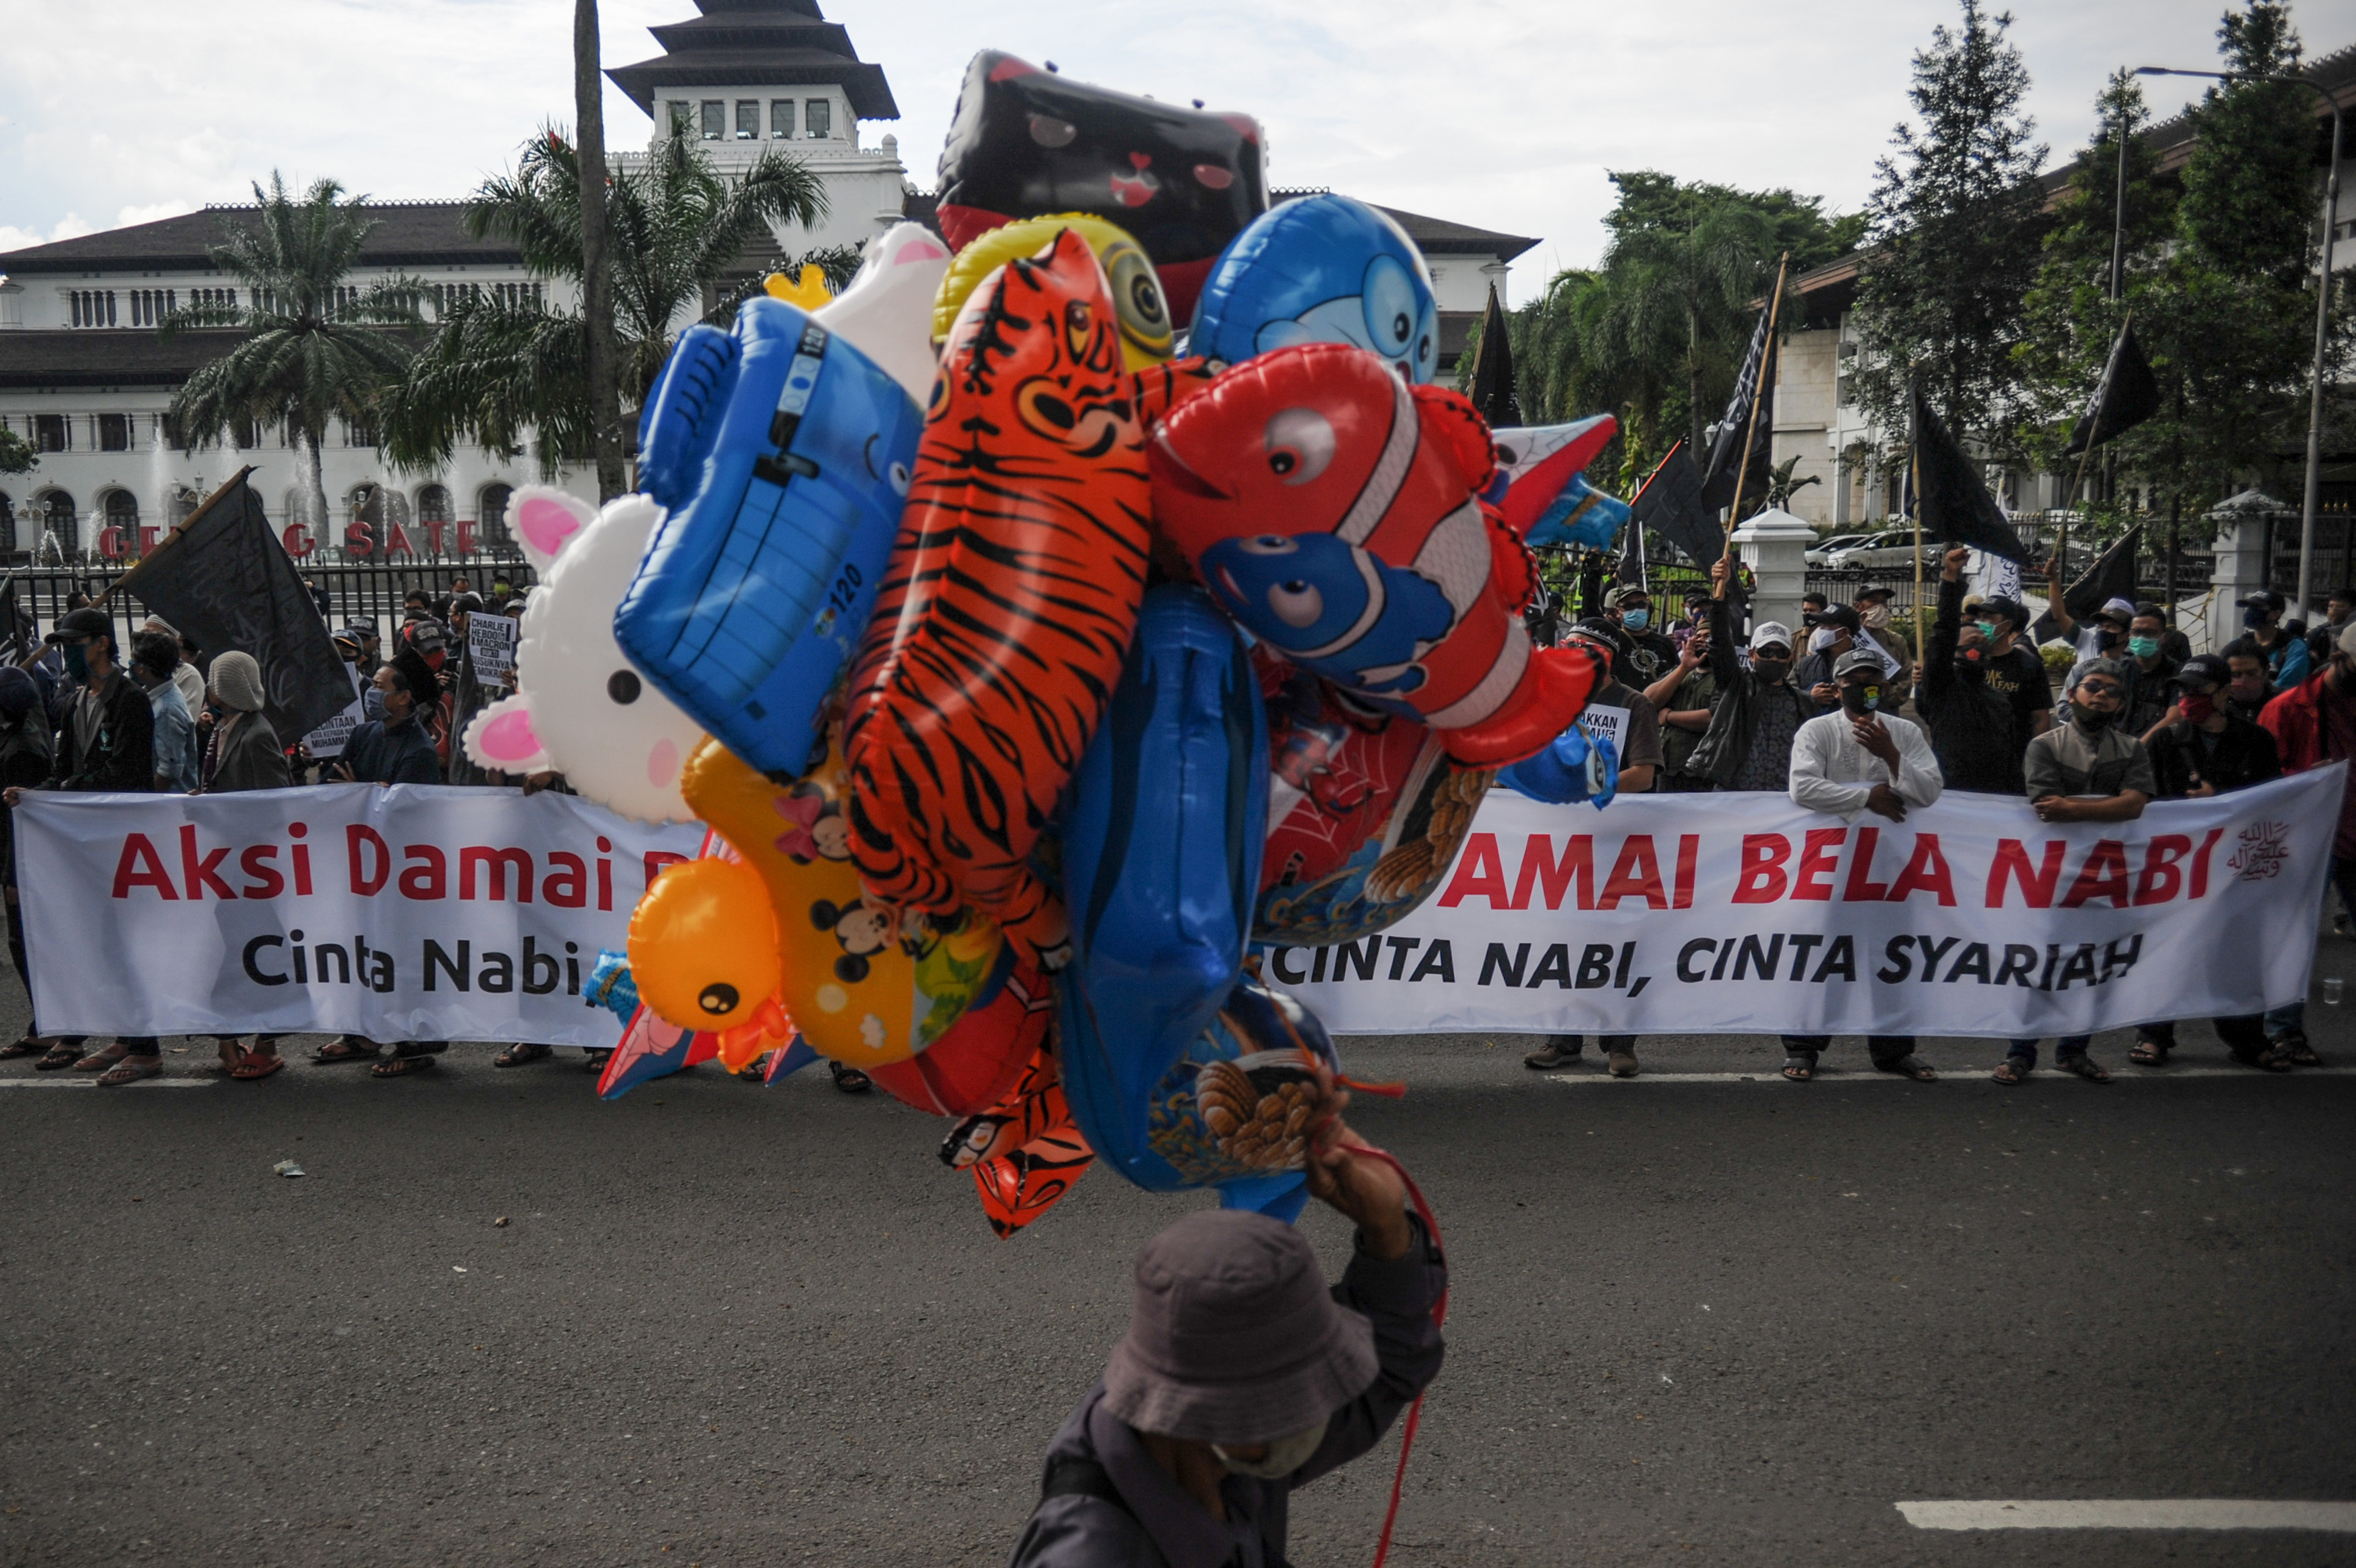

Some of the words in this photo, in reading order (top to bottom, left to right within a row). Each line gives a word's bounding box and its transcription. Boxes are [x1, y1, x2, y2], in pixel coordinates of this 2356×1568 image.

[802, 328, 825, 353] 120
[346, 520, 478, 557] SATE
[830, 563, 862, 613] 120
[471, 618, 505, 631] CHARLIE
[477, 638, 510, 651] MACRON
[1580, 712, 1619, 729] AKKAN
[312, 736, 349, 748] MUHAMMA
[112, 821, 313, 901] Aksi
[346, 824, 613, 912] Damai
[1437, 832, 1700, 911] AMAI
[1730, 826, 1957, 907] BELA
[1985, 828, 2224, 909] NABI
[242, 928, 395, 994] Cinta
[1272, 934, 1455, 984] CINTA
[1477, 941, 1652, 998] NABI,
[1676, 933, 1857, 983] CINTA
[1876, 933, 2144, 992] SYARIAH
